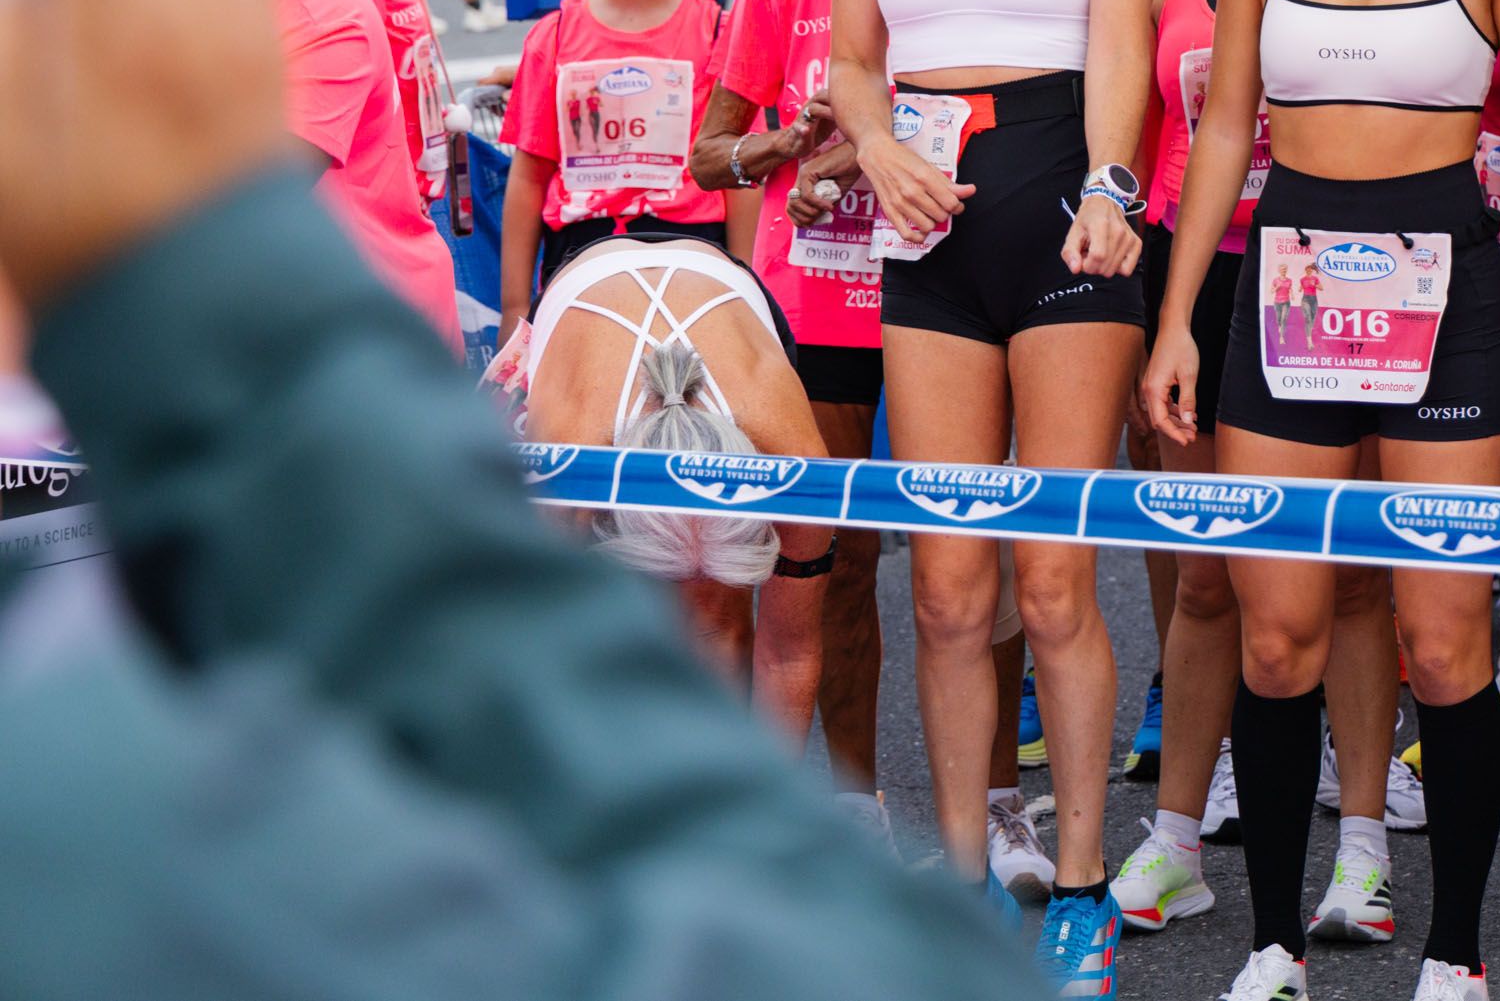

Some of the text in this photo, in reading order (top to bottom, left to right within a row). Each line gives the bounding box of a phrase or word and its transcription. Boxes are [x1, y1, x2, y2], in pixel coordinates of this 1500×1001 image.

[1318, 47, 1376, 61] OYSHO
[806, 229, 858, 242] CARRERA DE LA
[806, 247, 850, 261] OYSHO
[1277, 244, 1312, 255] SUMA
[1323, 256, 1390, 272] ASTURIANA
[845, 287, 882, 308] 202
[1322, 309, 1390, 337] 016
[1348, 343, 1364, 354] 17
[1279, 356, 1318, 366] CARRERA
[1321, 357, 1332, 366] DE
[1335, 357, 1346, 366] LA
[1348, 358, 1378, 368] MUJER
[1385, 359, 1391, 368] A
[1282, 375, 1338, 389] OYSHO
[1374, 381, 1417, 392] Santander
[1418, 405, 1481, 419] OYSHO
[680, 453, 796, 481] ASTURIANA
[726, 470, 770, 481] CENTRAL
[911, 466, 1033, 497] ASTURIANA
[1150, 482, 1274, 514] ASTURIANA
[15, 521, 96, 552] TO A SCIENCE
